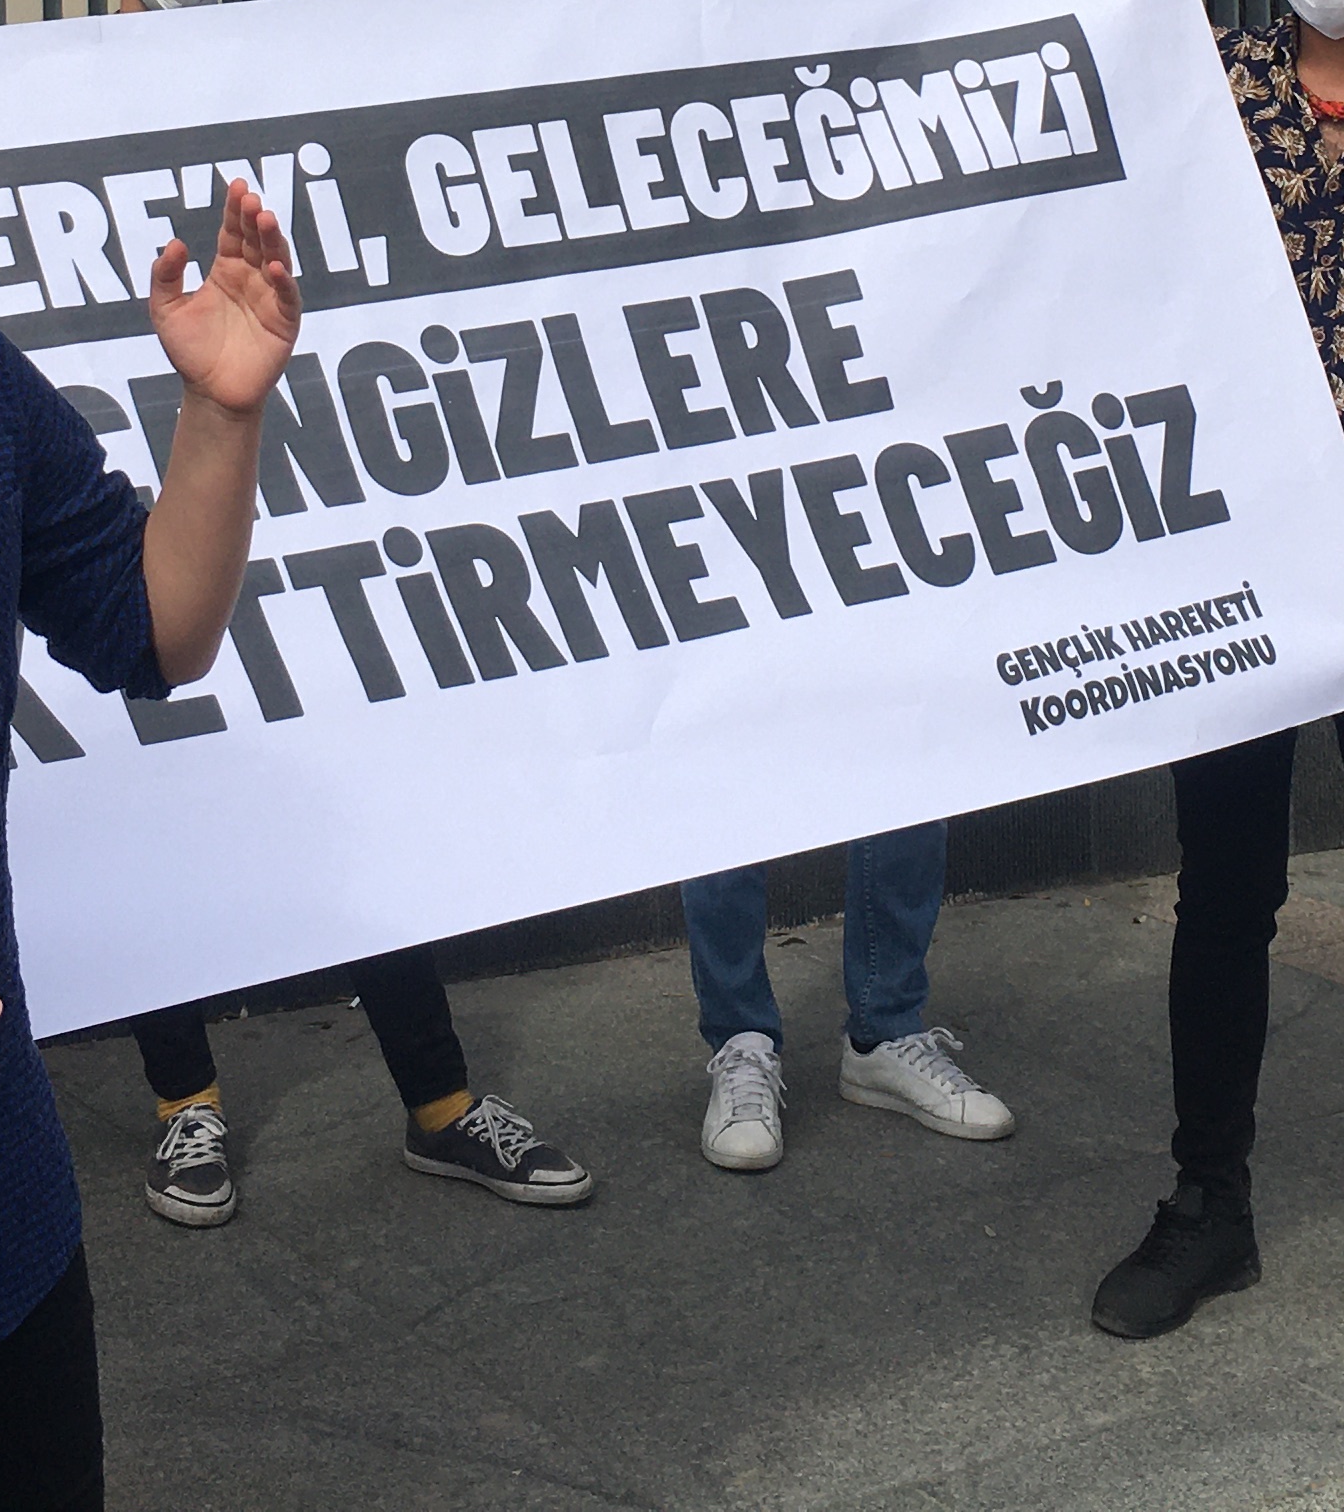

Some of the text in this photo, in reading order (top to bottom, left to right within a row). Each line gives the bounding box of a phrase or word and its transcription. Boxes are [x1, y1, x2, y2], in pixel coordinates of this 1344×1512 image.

[997, 580, 1264, 687] GENÇLİK HAREKETİ
[1019, 635, 1277, 736] KOORDİNASYONU
